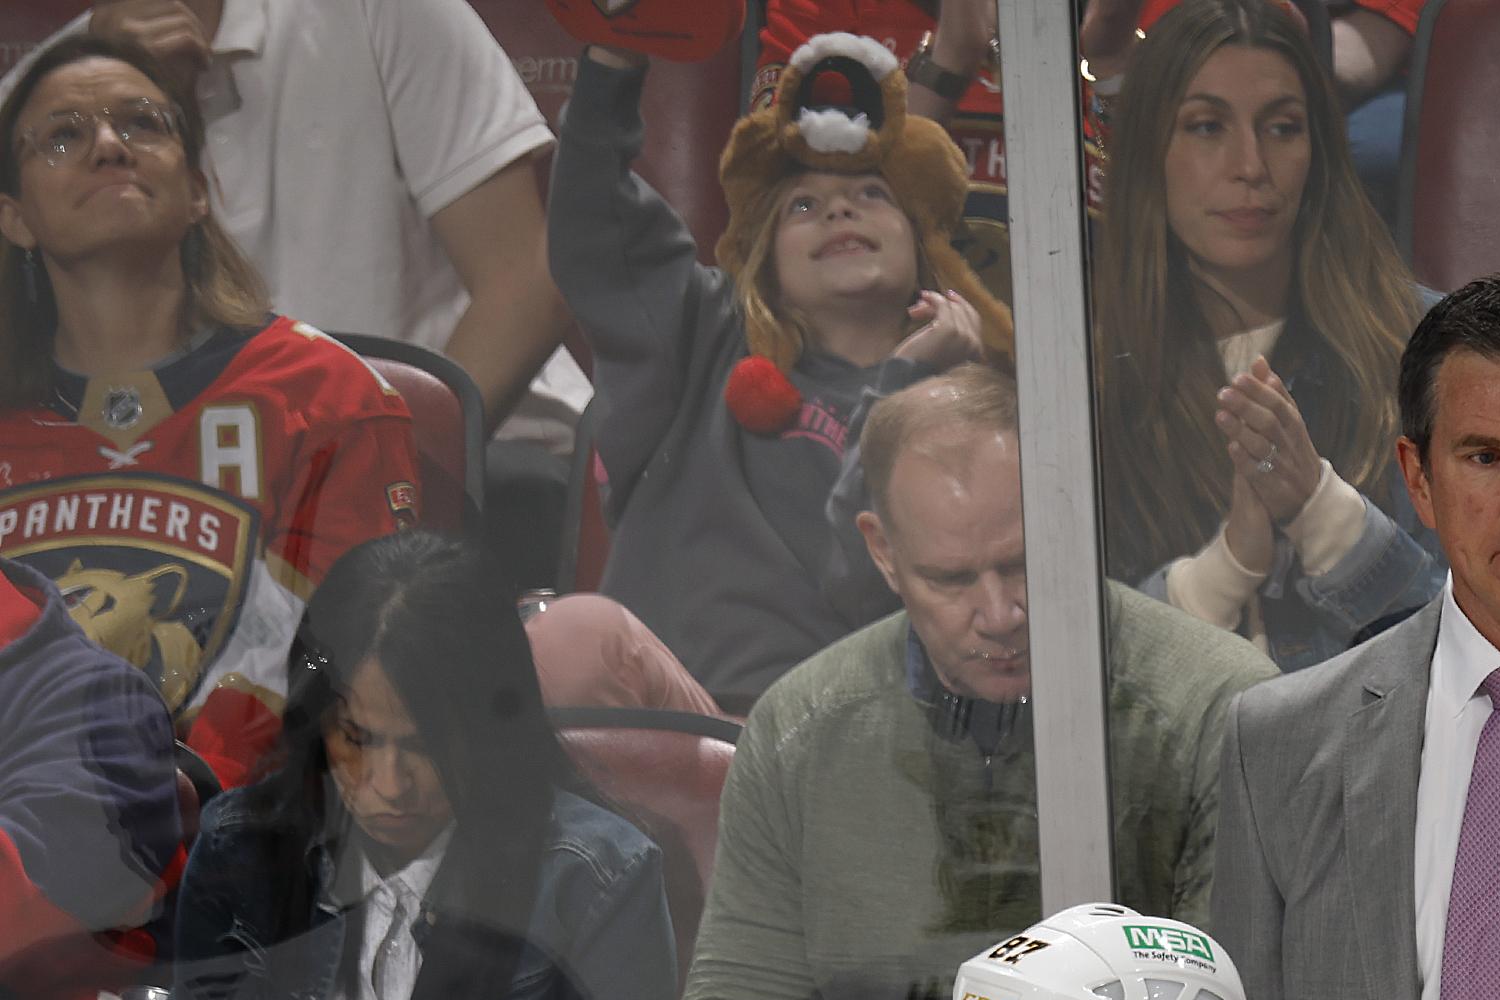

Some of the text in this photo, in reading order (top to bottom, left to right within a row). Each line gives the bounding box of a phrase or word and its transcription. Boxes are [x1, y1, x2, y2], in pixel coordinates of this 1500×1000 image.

[201, 404, 260, 500] A
[0, 494, 221, 552] PANTHERS
[988, 936, 1050, 965] 87
[1126, 926, 1213, 961] MSA
[1133, 950, 1217, 974] The Safety ompany
